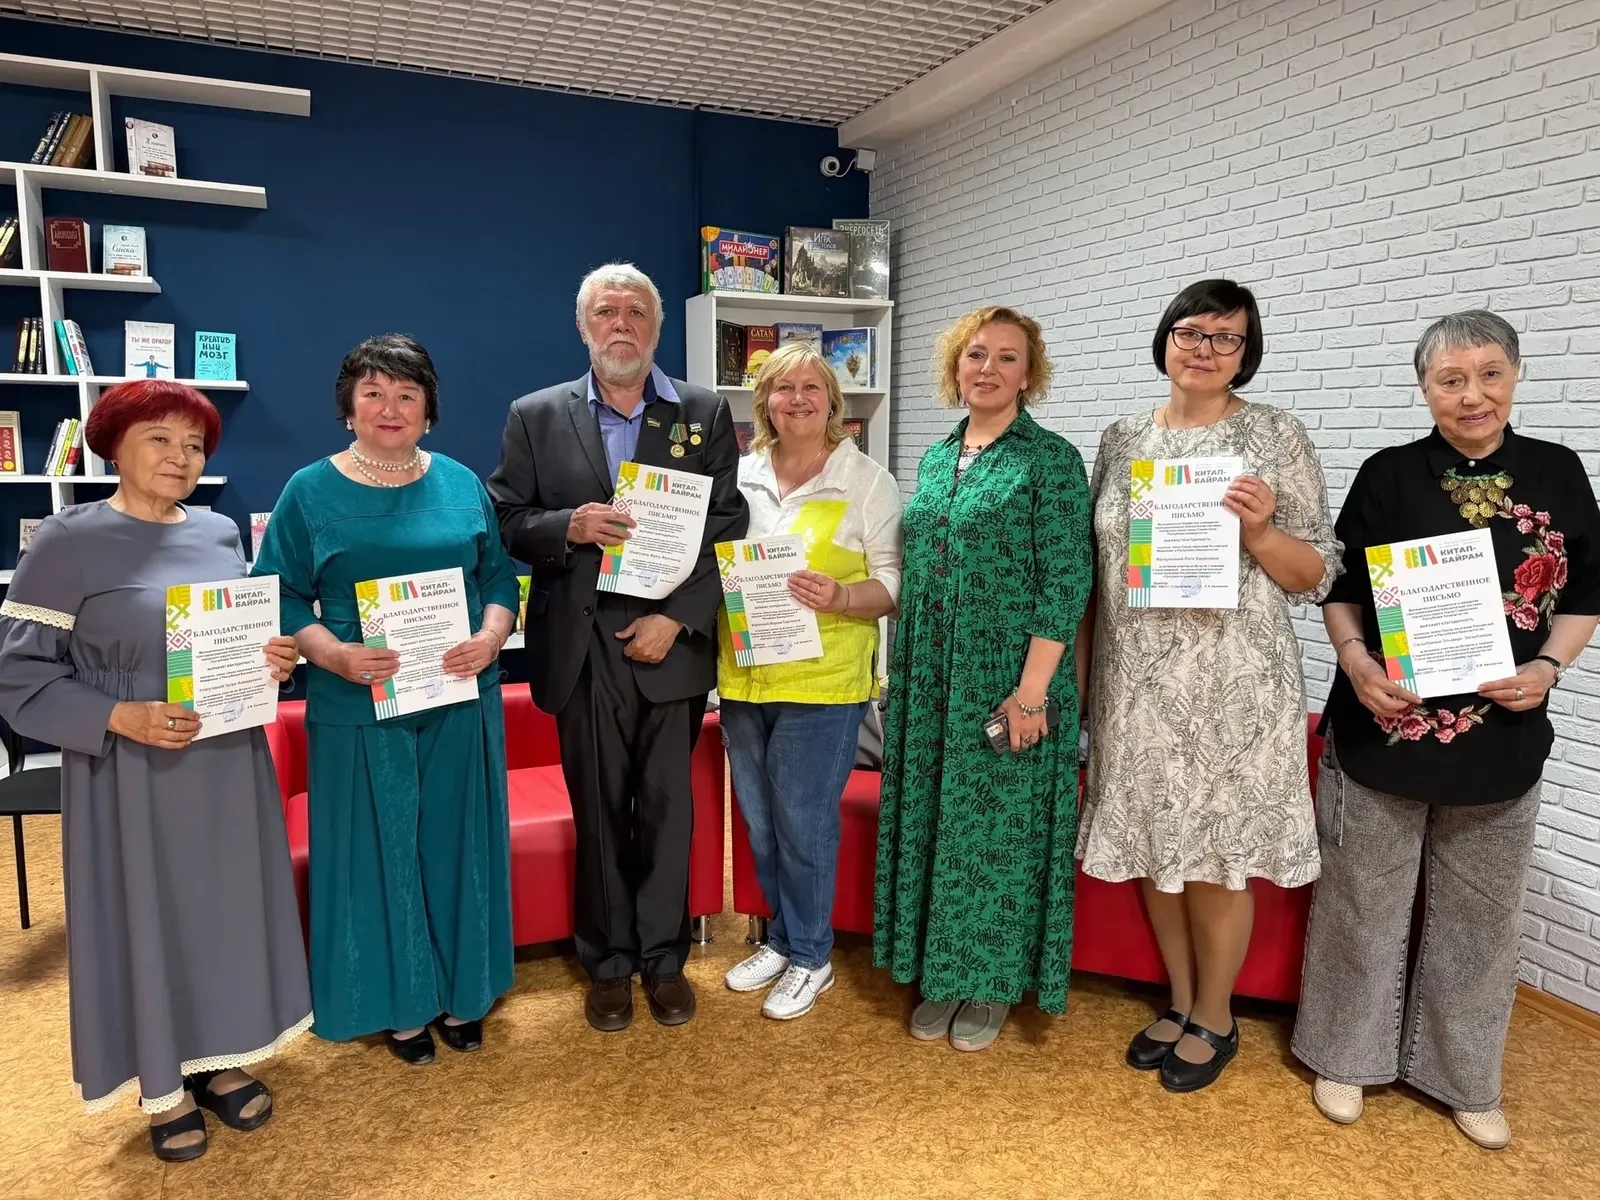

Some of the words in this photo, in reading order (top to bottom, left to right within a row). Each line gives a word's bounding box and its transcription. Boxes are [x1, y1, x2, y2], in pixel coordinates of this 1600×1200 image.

[814, 232, 831, 243] ИГРА
[721, 243, 767, 255] МИЛЛИОНЕР
[750, 329, 774, 337] CATAN
[199, 351, 229, 360] МОЗГ
[1195, 469, 1226, 477] КИТАП-
[1194, 476, 1231, 484] БАЙРАМ
[672, 482, 698, 492] КИТАП-
[670, 489, 701, 499] БАЙРАМ
[633, 500, 700, 516] БЛАГОДАРСТВЕННОЕ
[648, 511, 677, 521] ПИСЬМО
[767, 546, 792, 554] КИТАП-
[1440, 546, 1476, 556] КИТАП-
[768, 552, 797, 560] БАЙРАМ
[1441, 552, 1484, 564] БАЙРАМ
[420, 582, 450, 591] КИТАП-
[1400, 577, 1491, 596] БЛАГОДАРСТВЕННОЕ
[235, 591, 266, 600] КИТАП-
[421, 588, 456, 598] БАЙРАМ
[1422, 591, 1461, 603] ПИСЬМО
[235, 598, 271, 608] БАЙРАМ
[383, 602, 460, 619] БЛАГОДАРСТВЕННОЕ
[403, 614, 437, 624] ПИСЬМО
[193, 620, 274, 638] БЛАГОДАРСТВЕННОЕ
[213, 634, 248, 645] ПИСЬМО
